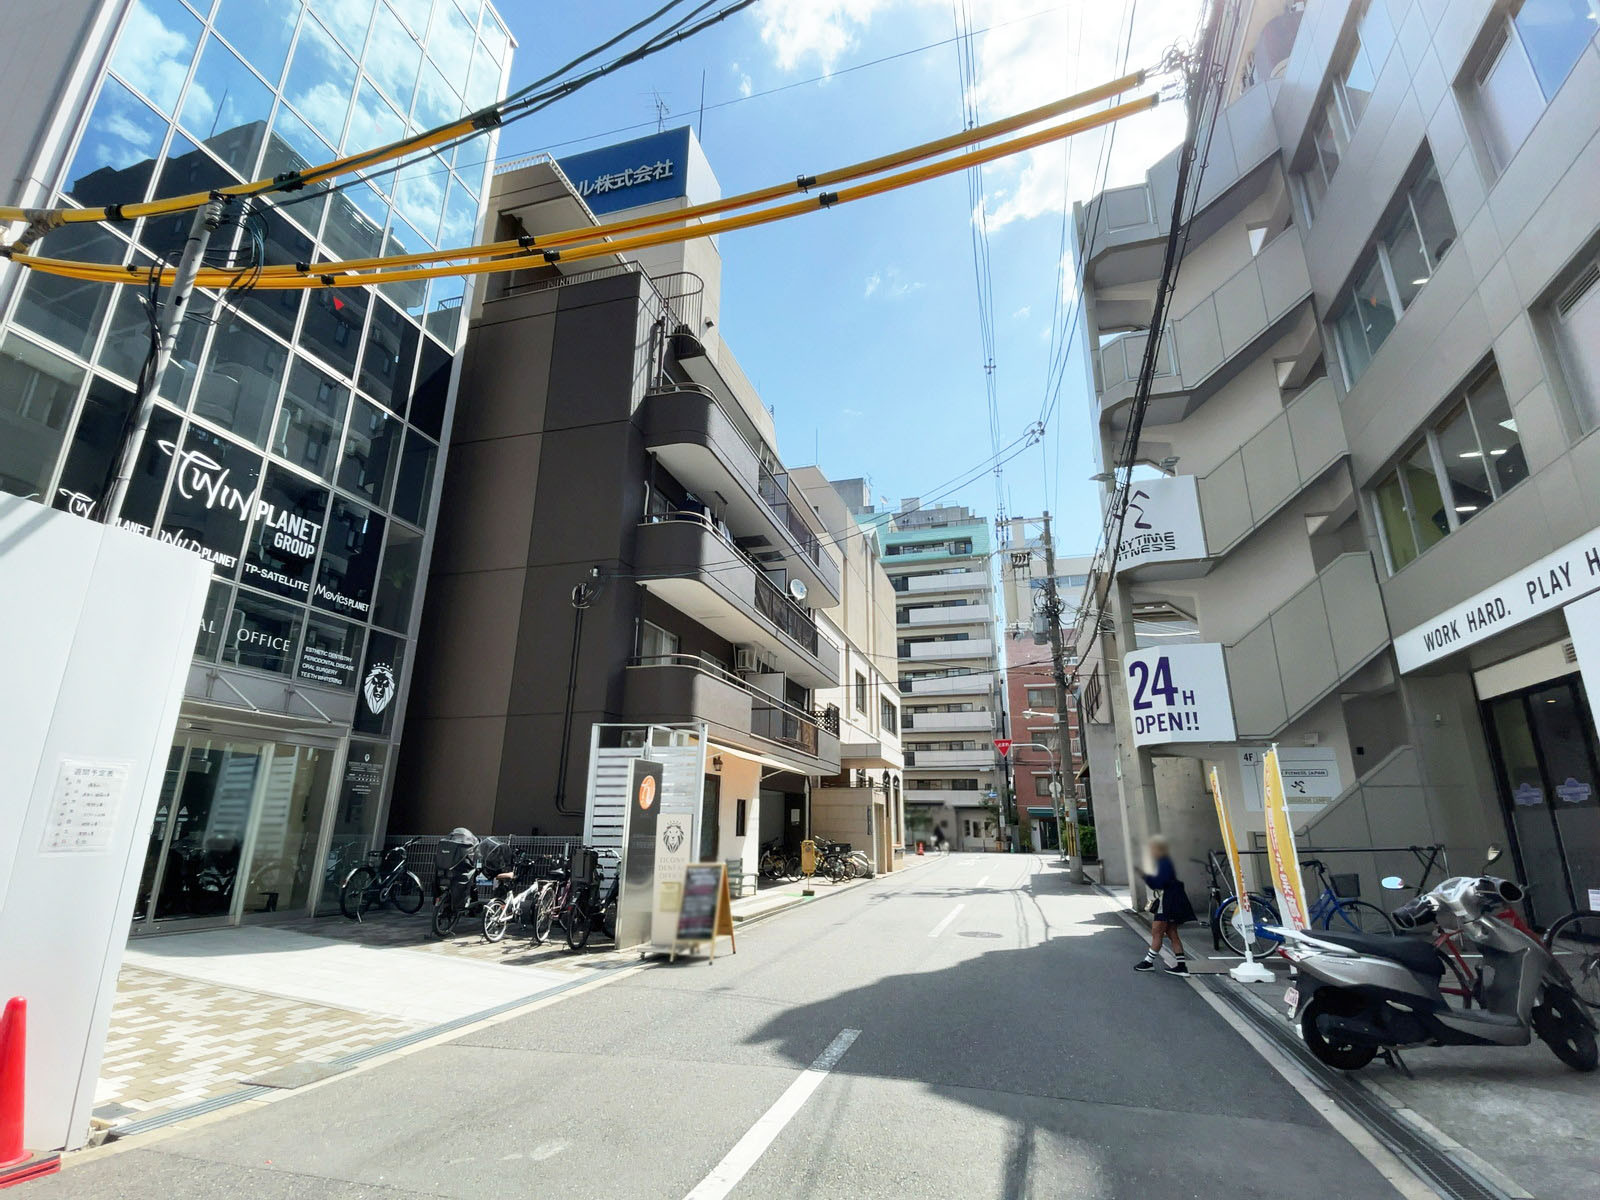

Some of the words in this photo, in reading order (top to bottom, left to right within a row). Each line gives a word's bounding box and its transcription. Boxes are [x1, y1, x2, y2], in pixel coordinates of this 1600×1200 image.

[576, 159, 674, 196] ル株式会社
[116, 517, 151, 538] LANET
[254, 499, 322, 544] PLANET
[273, 532, 315, 560] GROUP
[1118, 542, 1176, 562] ITNESS
[1119, 531, 1175, 552] NYTIME
[201, 547, 237, 569] PLANET
[244, 562, 310, 592] TP-SATELLITE
[348, 599, 370, 613] PLANET
[1423, 619, 1461, 652] WORK
[1466, 597, 1512, 633] HARD.
[1526, 561, 1572, 605] PLAY
[1585, 547, 1600, 576] H
[199, 619, 216, 634] AL
[236, 628, 291, 652] OFFICE
[303, 654, 336, 668] PERIODONTAL
[335, 662, 355, 672] DISEASE
[305, 646, 328, 657] ESTHETIC
[328, 651, 353, 663] DENTISTRY
[300, 670, 318, 680] TEETH
[317, 674, 343, 685] WHITENING
[301, 662, 316, 671] ORAL
[315, 665, 339, 676] SURGERY
[1135, 711, 1200, 735] OPEN!!
[1243, 752, 1254, 762] 4F
